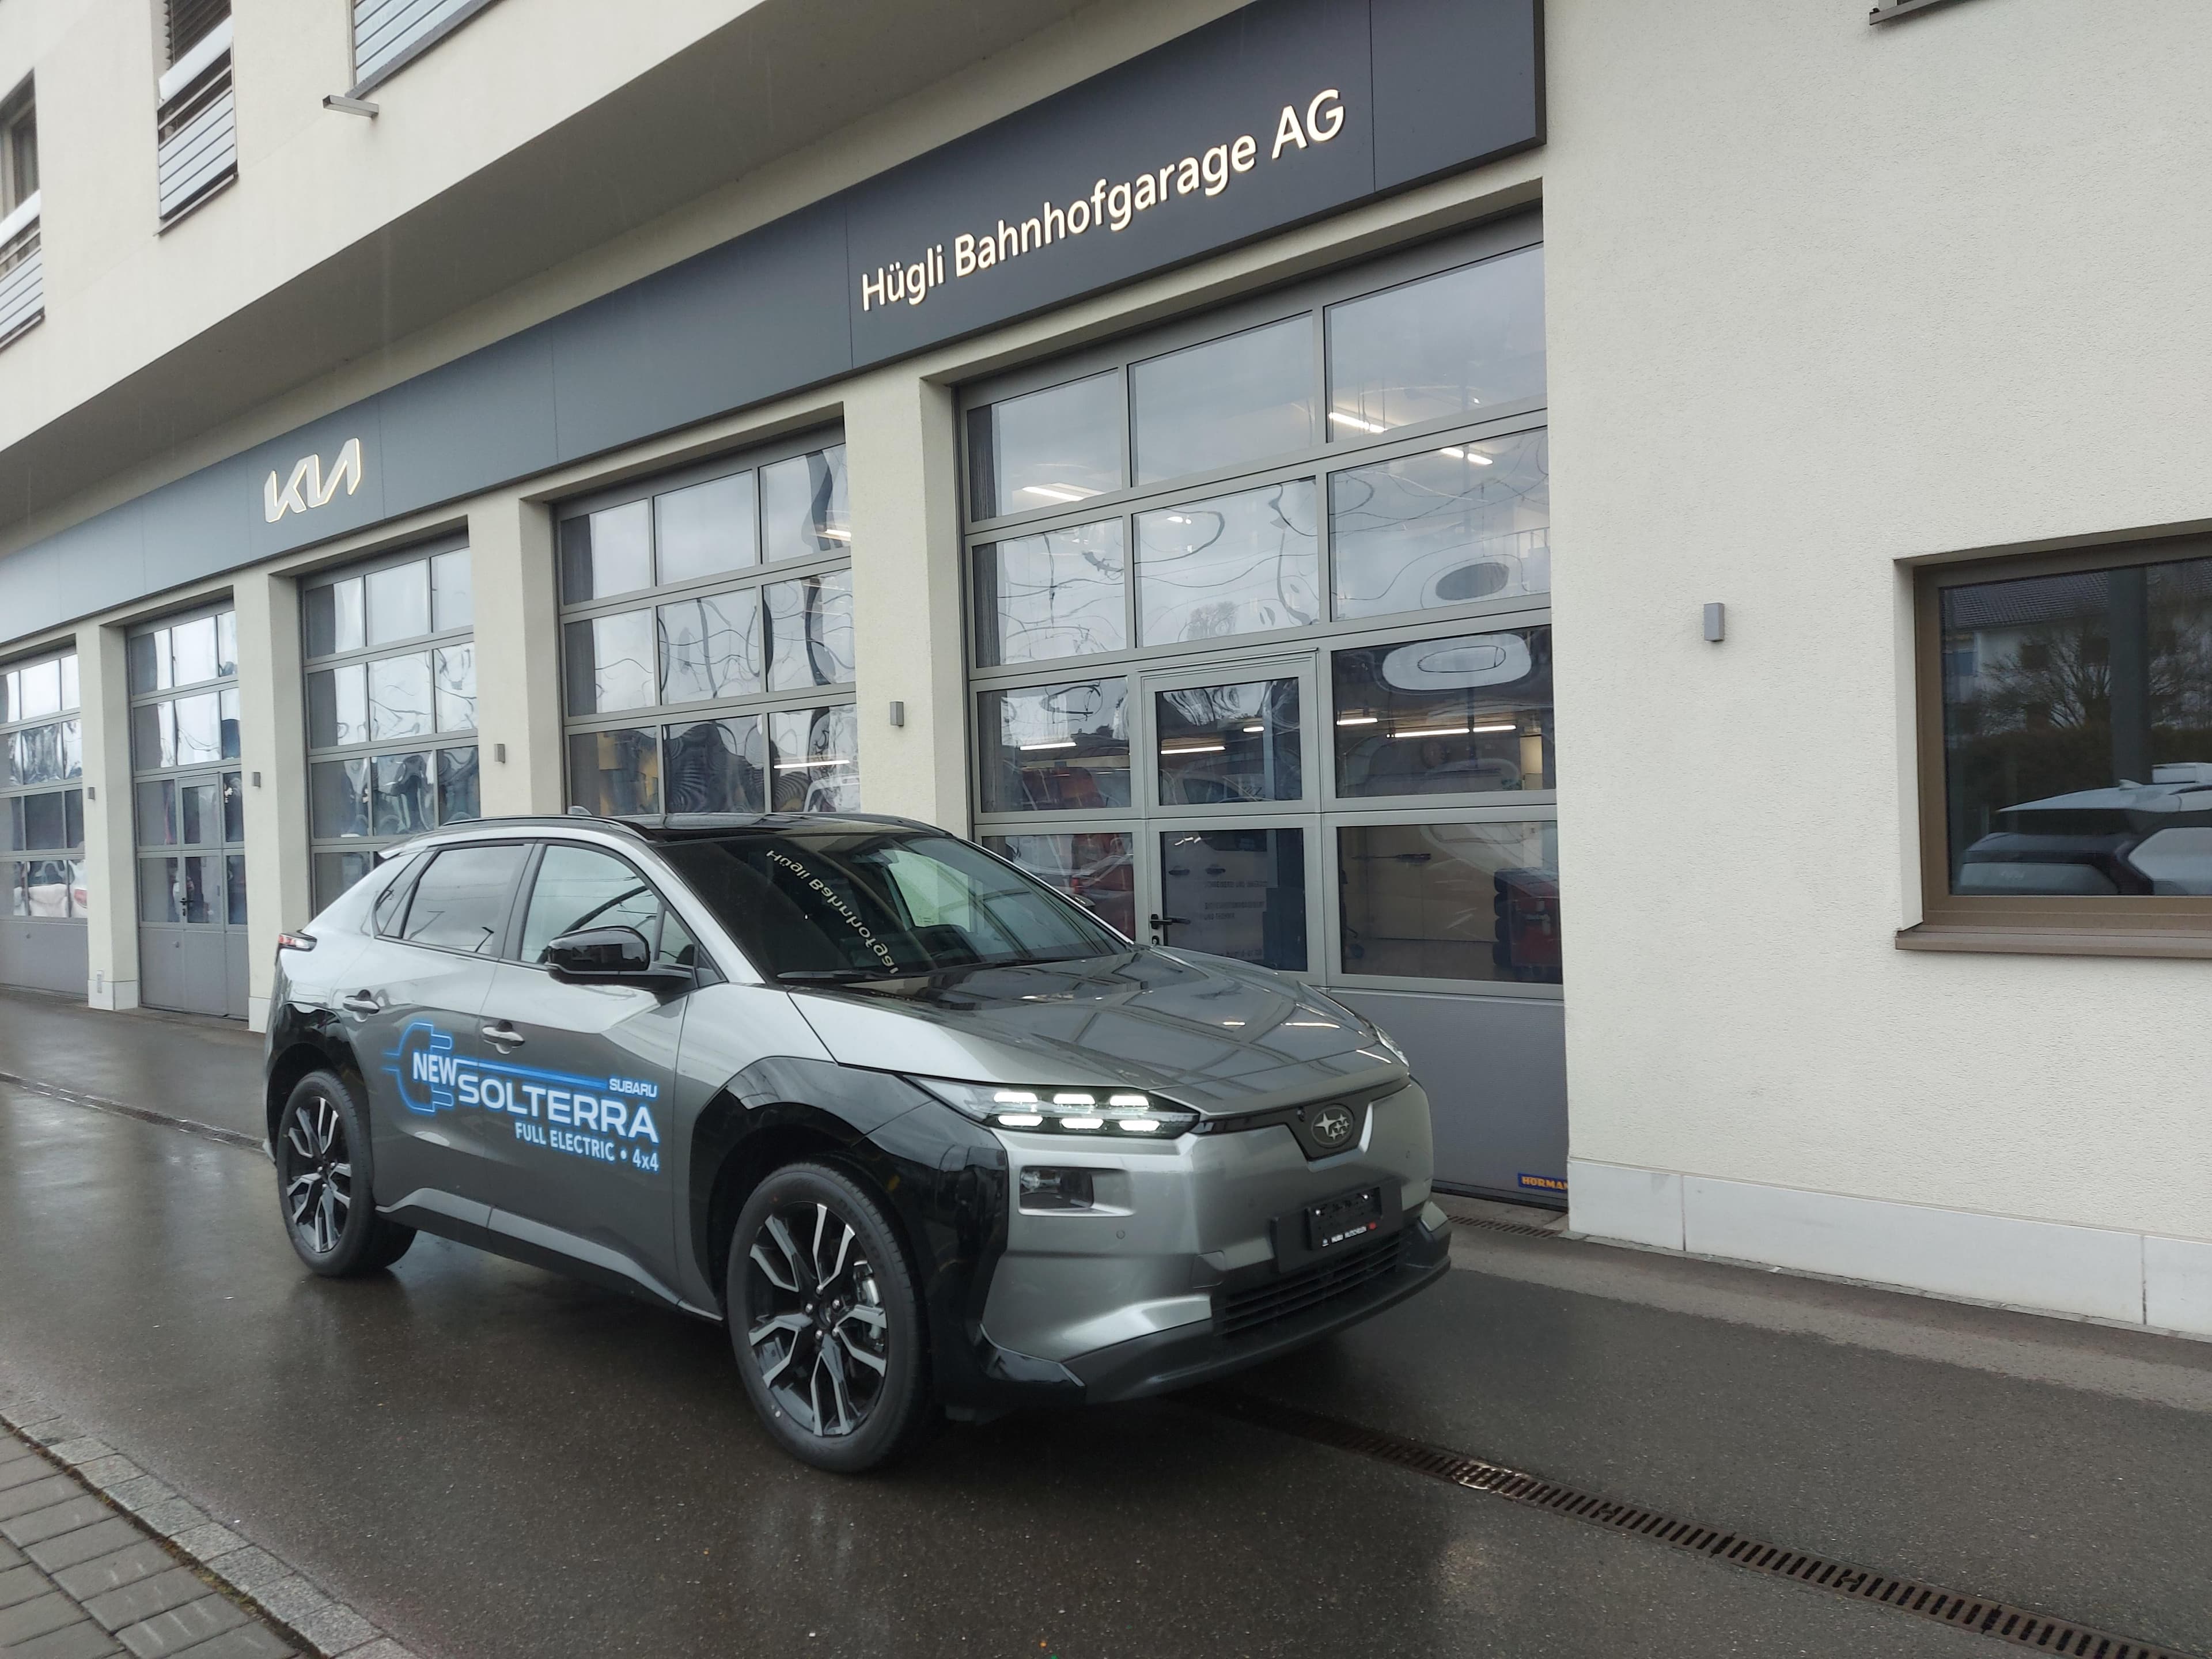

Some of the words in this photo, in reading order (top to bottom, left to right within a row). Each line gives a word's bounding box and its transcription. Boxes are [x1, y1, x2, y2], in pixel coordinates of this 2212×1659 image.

[862, 245, 945, 312] Hügli
[954, 134, 1256, 279] Bahnhofgarage
[1271, 89, 1346, 160] AG
[264, 437, 362, 523] KIA
[412, 1052, 459, 1086] NEW
[609, 1078, 658, 1098] SUBARU
[458, 1075, 660, 1143] SOLTERRA
[515, 1122, 547, 1145] FULL
[550, 1130, 615, 1161] ELECTRIC
[632, 1149, 660, 1172] 4x4
